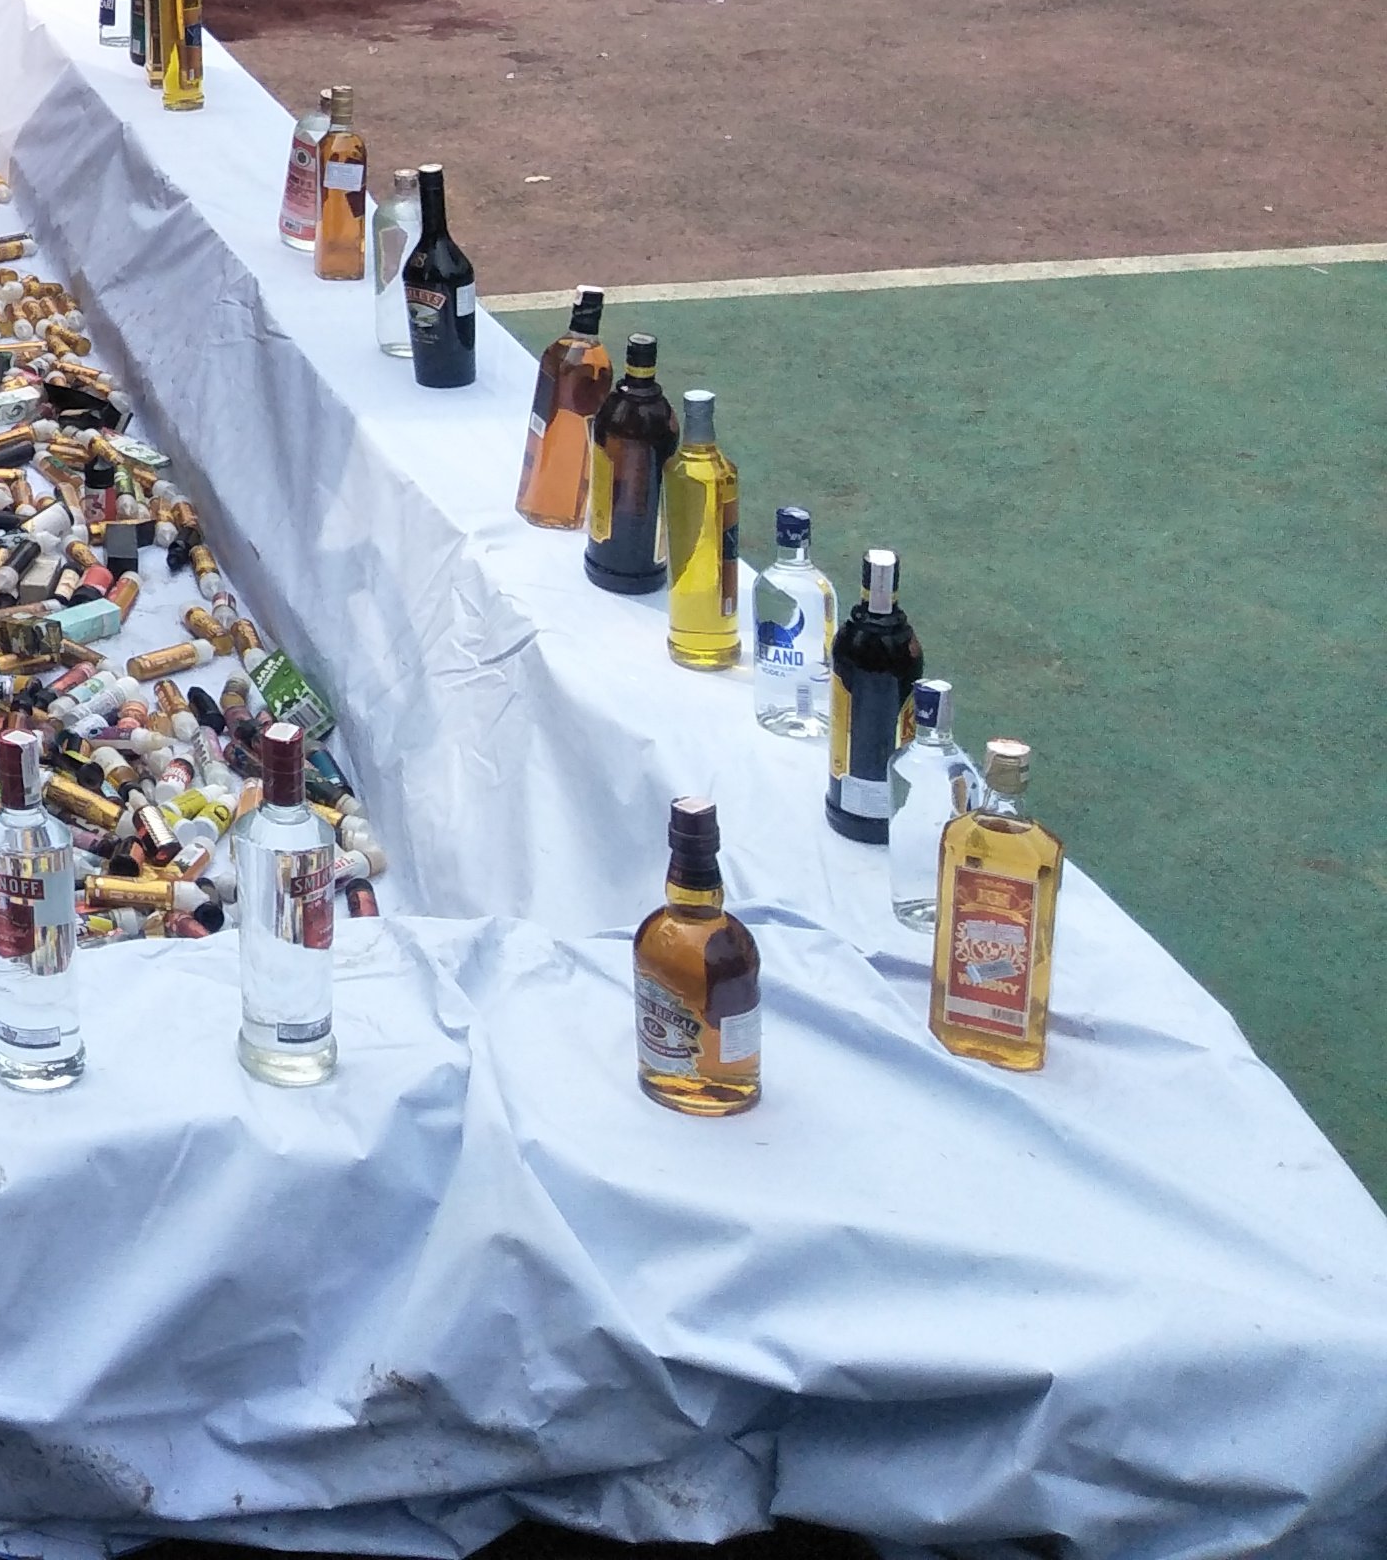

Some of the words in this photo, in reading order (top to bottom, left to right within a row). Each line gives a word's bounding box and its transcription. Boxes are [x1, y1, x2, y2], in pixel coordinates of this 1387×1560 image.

[406, 287, 441, 305] ILEYS
[256, 658, 276, 686] JAM
[654, 1003, 700, 1037] REGAL
